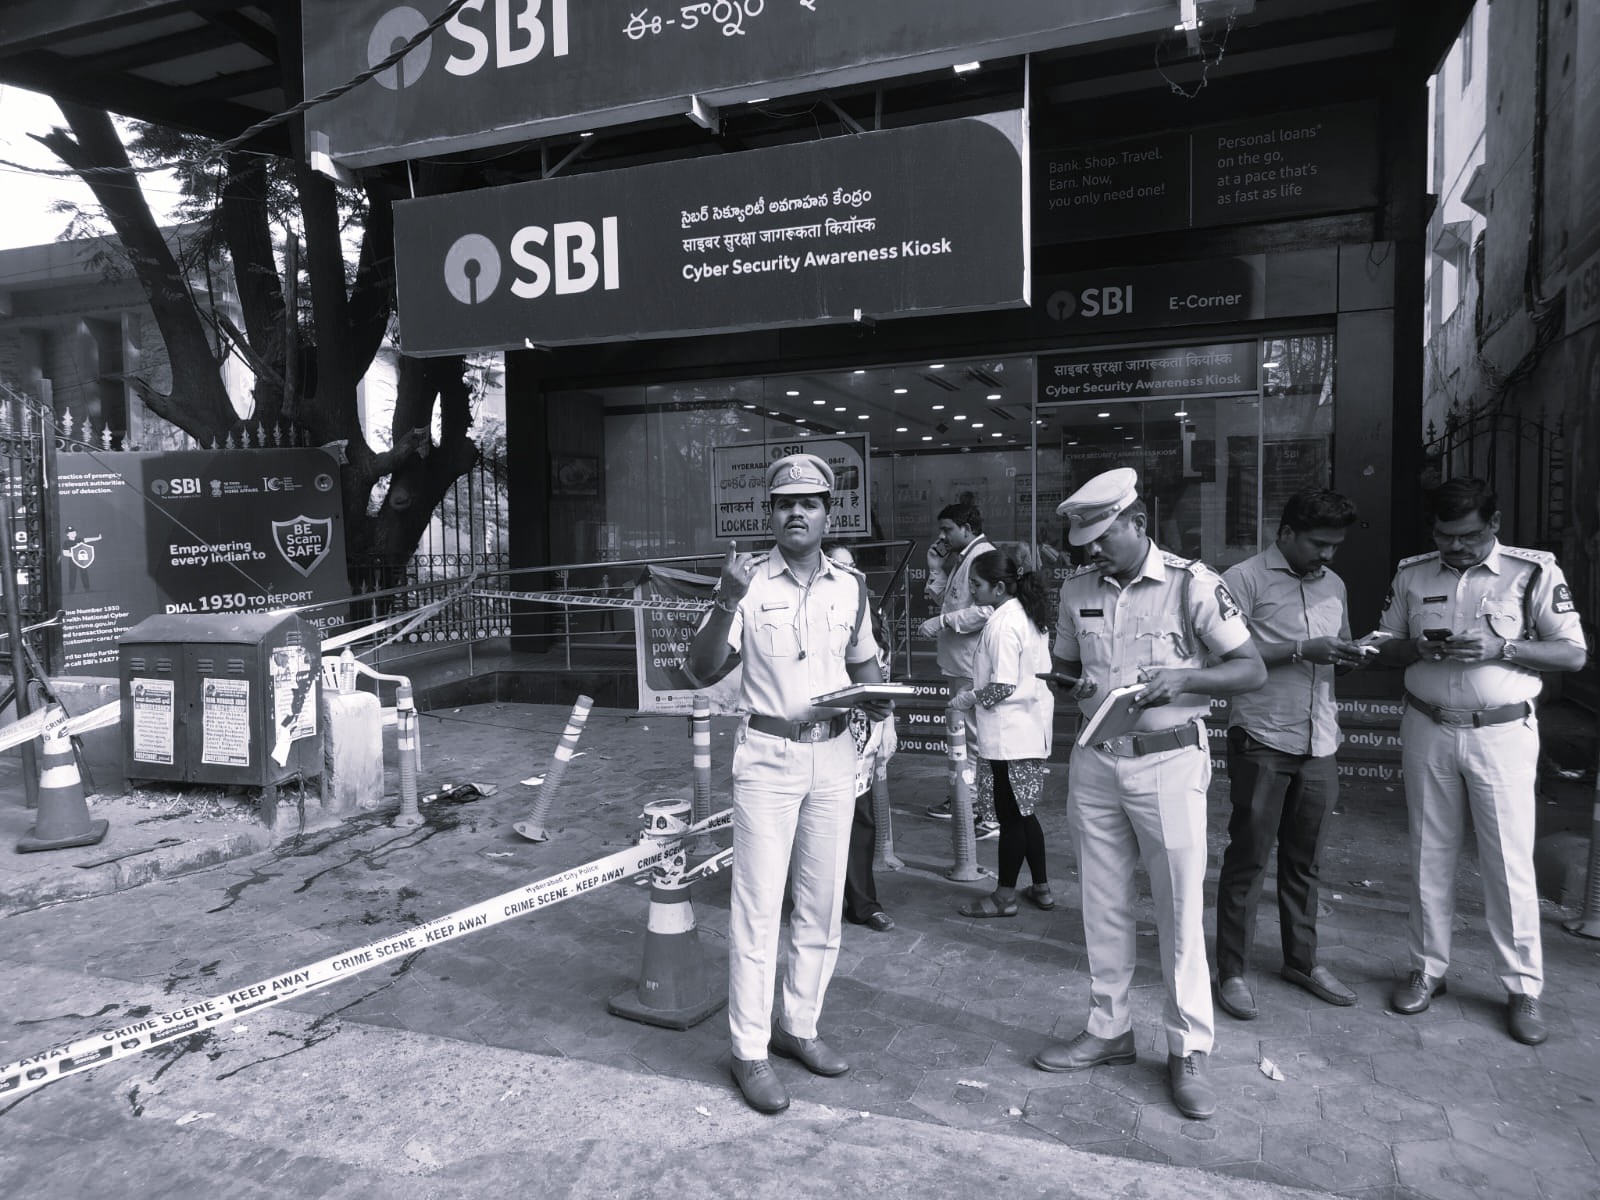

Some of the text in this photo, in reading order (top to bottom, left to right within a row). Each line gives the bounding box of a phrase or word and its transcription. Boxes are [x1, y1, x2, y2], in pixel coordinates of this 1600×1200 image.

[444, 0, 568, 76] SBI
[1218, 130, 1276, 150] Personal
[1049, 147, 1163, 175] Bank. Shop. Travel.
[1217, 150, 1284, 169] on the go,
[1049, 176, 1079, 192] Earn.
[1217, 162, 1318, 188] at a pace that's
[1049, 182, 1166, 211] you only need one!
[1217, 183, 1303, 206] as fast as life
[681, 187, 872, 229] సైబర్ సెక్యూరిటీ అవగాహన కేంద్రం
[682, 215, 877, 253] साइबर सुरक्षा जागरूकता कियॉस्क
[510, 216, 620, 299] SBI
[682, 238, 952, 283] Cyber Security Awareness Kiosk
[1080, 284, 1243, 318] SBI E-Corner
[1054, 362, 1090, 377] साइबर
[1092, 358, 1123, 378] सुरक्षा
[1125, 353, 1183, 372] जागरूकता
[1045, 372, 1241, 397] Cyber Security Awareness Kiosk
[170, 477, 201, 495] SBI
[293, 523, 313, 535] BE
[721, 519, 759, 532] LOCKER
[169, 541, 252, 556] Empowering
[286, 533, 322, 546] Scam
[170, 549, 266, 567] every Indian to
[287, 545, 323, 558] SAFE
[165, 602, 197, 615] DIAL
[199, 593, 246, 611] 1930
[248, 595, 266, 606] TO
[267, 590, 314, 604] REPORT
[328, 615, 345, 626] ON
[651, 610, 700, 625] to every
[680, 626, 698, 641] giv
[652, 641, 692, 656] power
[653, 655, 687, 670] every
[916, 685, 937, 697] you
[908, 713, 947, 725] you on
[900, 740, 923, 751] you
[1349, 732, 1384, 746] only
[1337, 766, 1354, 776] ou
[1357, 764, 1393, 780] only
[504, 897, 536, 917] CRIME
[537, 886, 569, 906] SCENE
[575, 876, 599, 892] KEEP
[601, 866, 626, 884] AWAY
[637, 851, 663, 870] CRIME
[102, 1020, 159, 1042] CRIME
[161, 1001, 216, 1025] SCENE
[227, 985, 267, 1005] KEEP
[271, 970, 311, 991] AWAY
[332, 949, 374, 972] CRIME
[375, 937, 417, 958] SCENE
[425, 924, 456, 943] KEEP
[458, 913, 488, 933] AWAY
